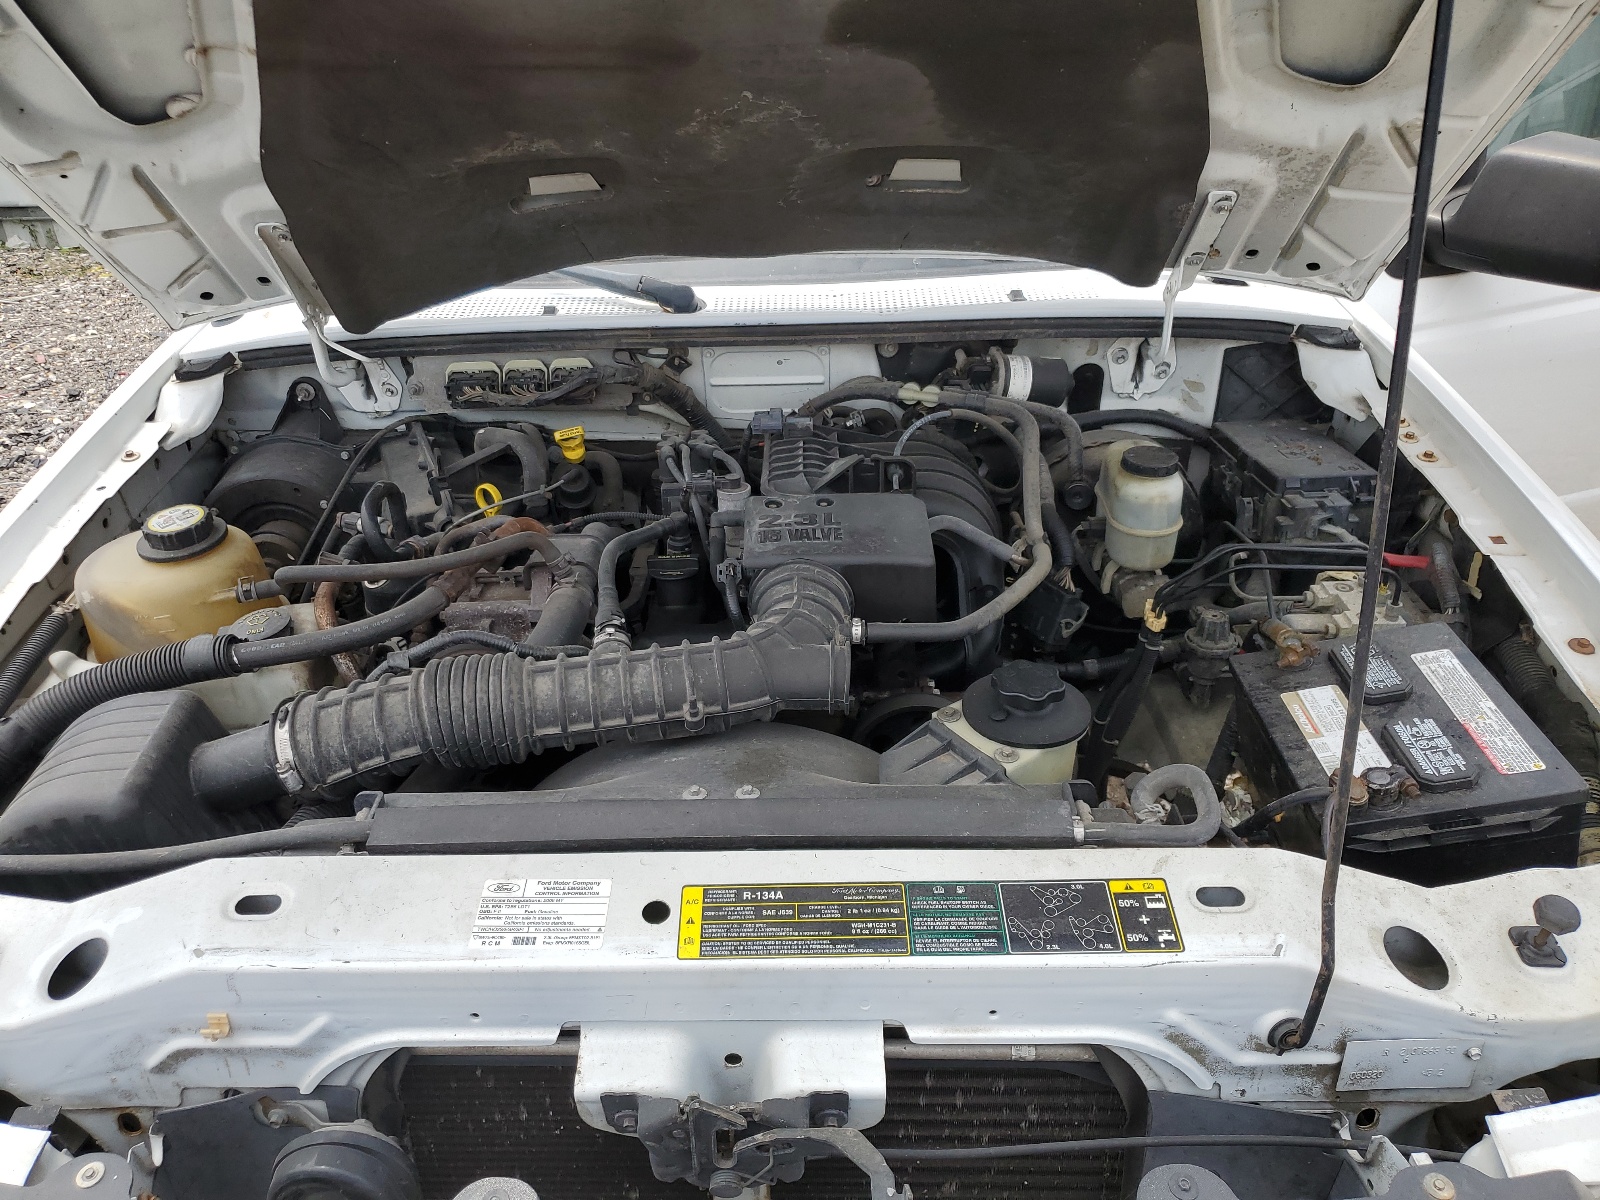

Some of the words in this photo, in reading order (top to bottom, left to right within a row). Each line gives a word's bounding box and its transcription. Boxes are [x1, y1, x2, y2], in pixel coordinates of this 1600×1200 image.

[757, 512, 842, 528] 2.3L
[757, 529, 782, 544] 16
[786, 527, 843, 542] VALVE
[246, 627, 265, 635] ONLY
[743, 891, 784, 900] R-134A
[1118, 899, 1140, 907] 50%
[1127, 934, 1149, 942] 50%
